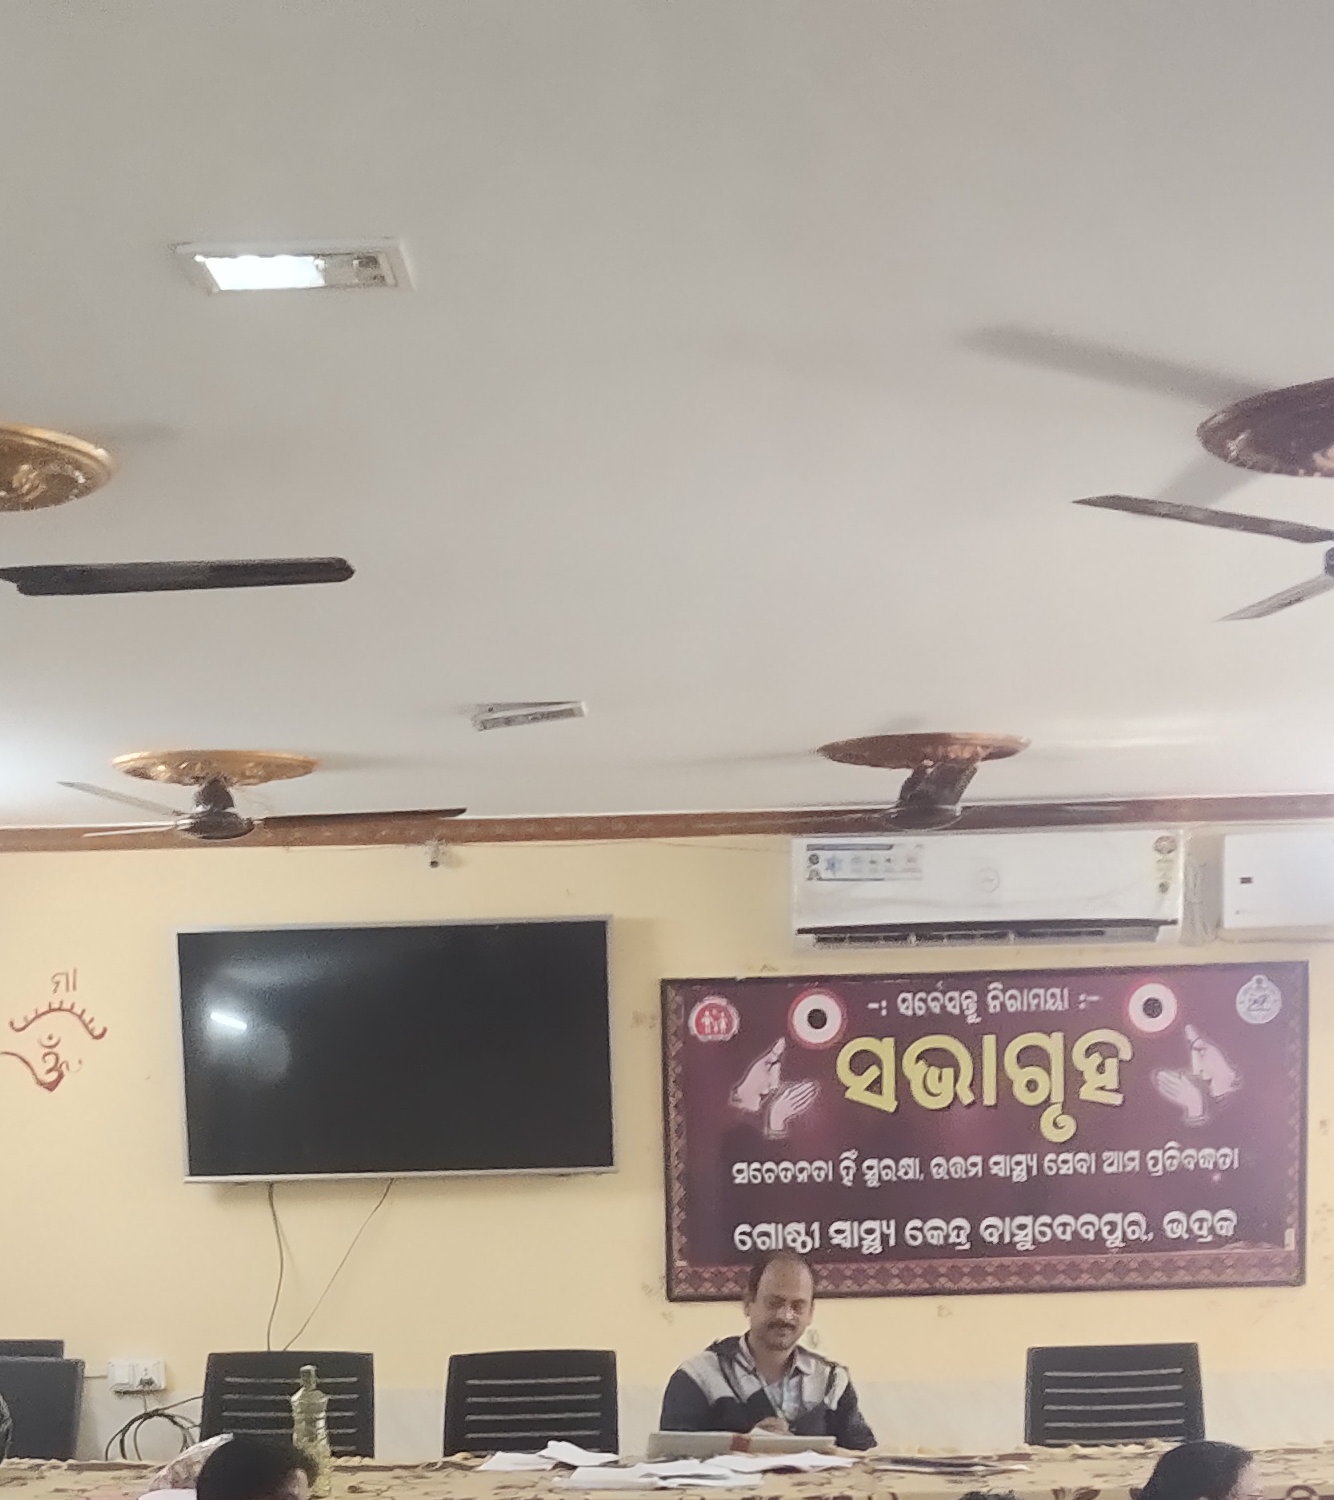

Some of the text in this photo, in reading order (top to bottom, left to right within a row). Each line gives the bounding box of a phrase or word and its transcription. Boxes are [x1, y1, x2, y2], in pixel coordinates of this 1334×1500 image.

[836, 1028, 1135, 1143] ସଭାଗୃହ
[732, 1160, 834, 1184] ସଚେତନତା
[1043, 1150, 1096, 1176] ସେବା
[1101, 1149, 1141, 1174] ଆମ
[733, 1221, 821, 1254] ଗୋଷ୍ଠୀ
[904, 1217, 972, 1251] କେନ୍ଦ୍ର
[1163, 1208, 1238, 1243] ଭଦ୍ରକ
